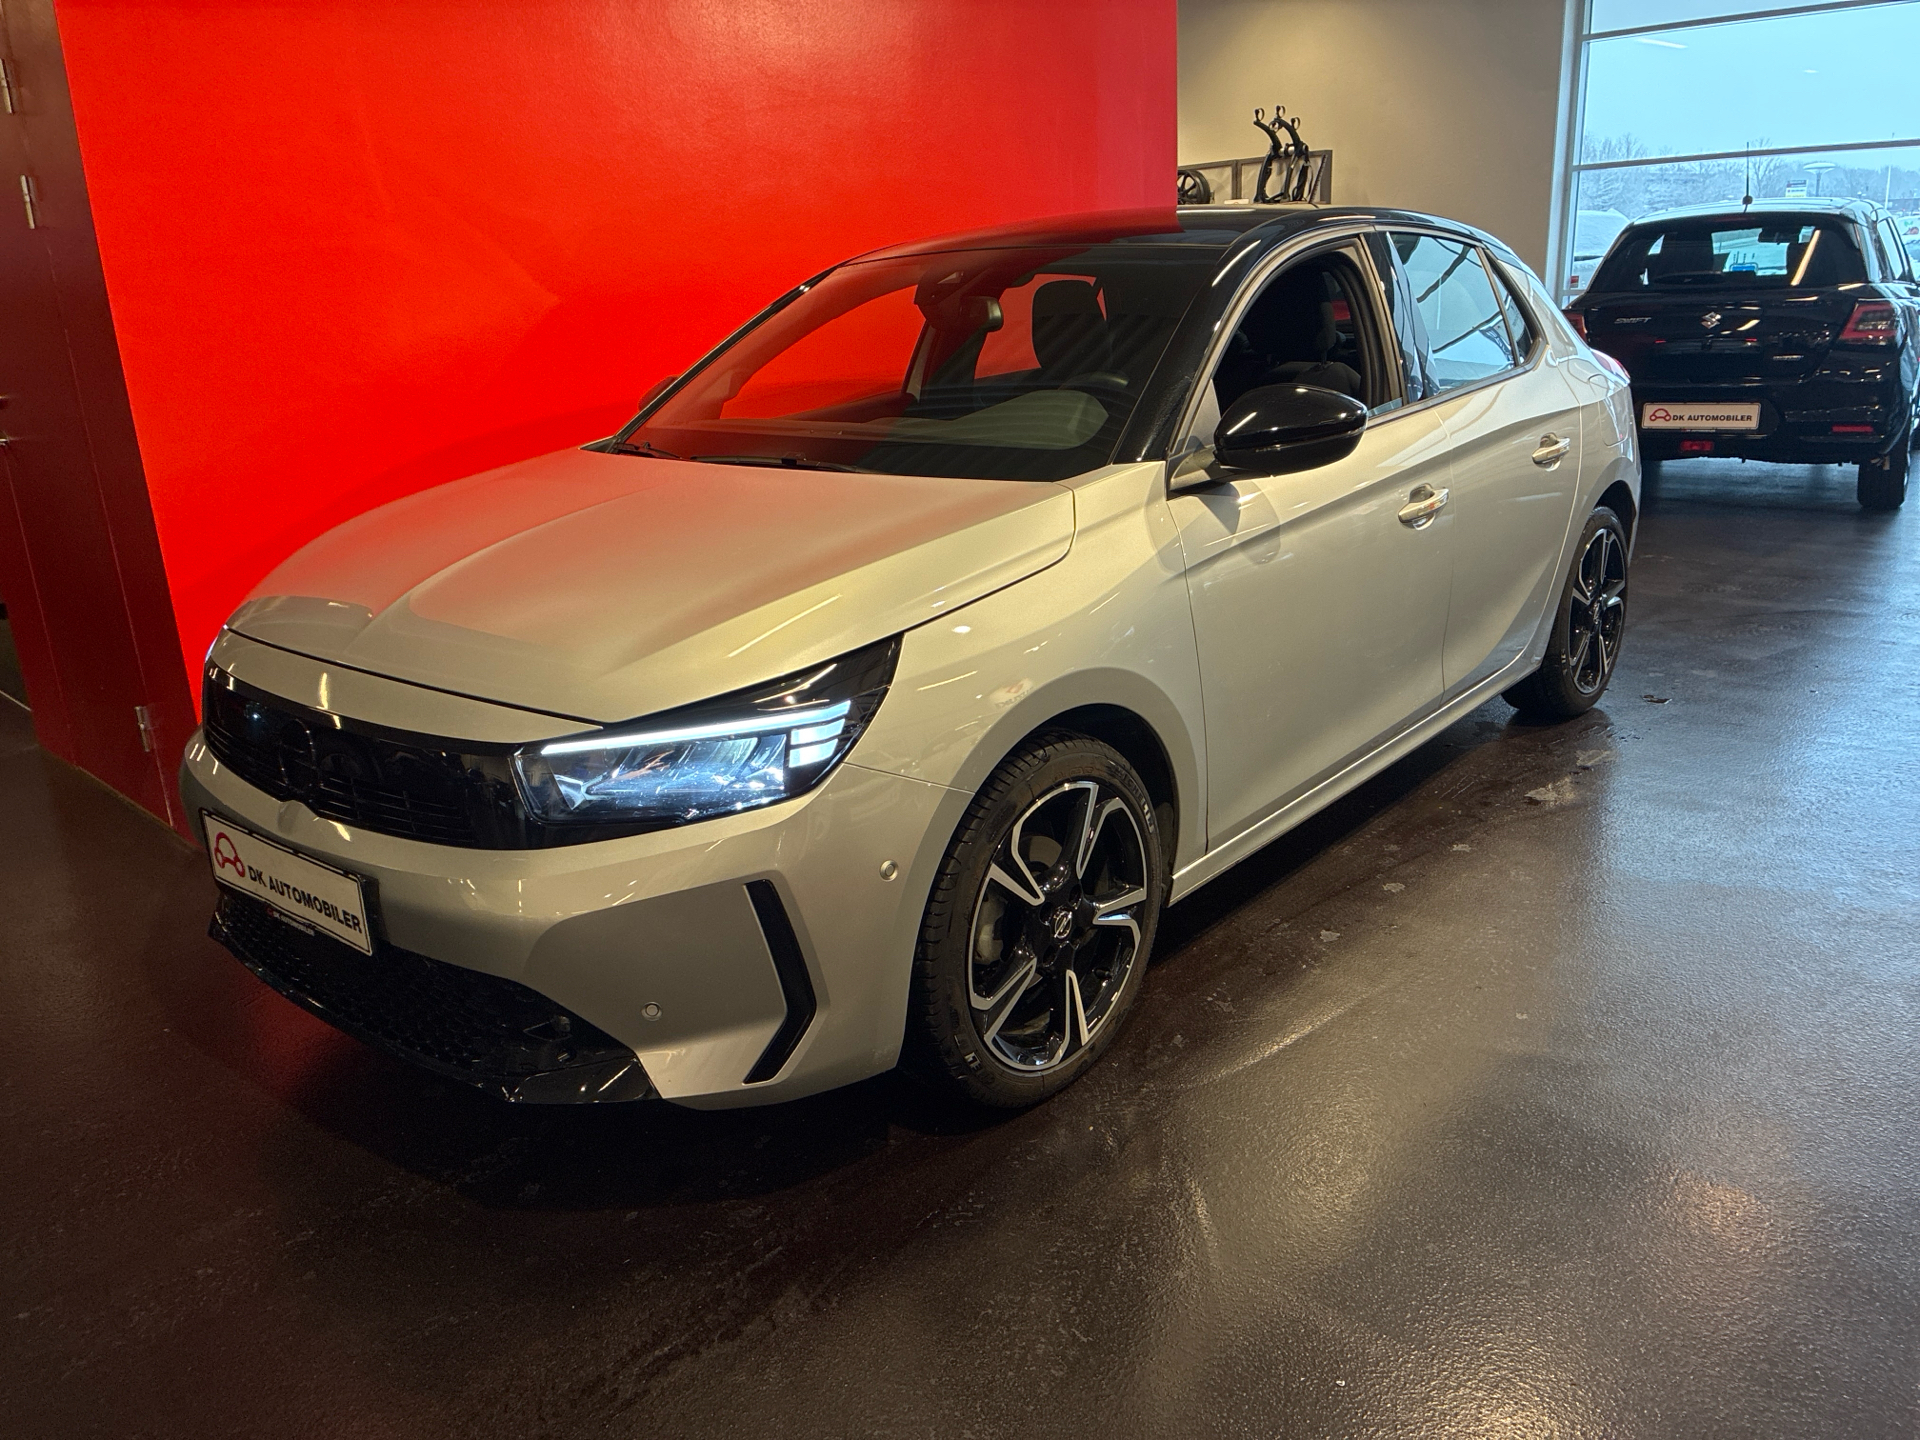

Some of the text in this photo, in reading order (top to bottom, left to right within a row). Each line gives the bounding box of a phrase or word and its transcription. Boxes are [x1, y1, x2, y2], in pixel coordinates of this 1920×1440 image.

[1672, 414, 1753, 422] DK AUTOMOBILER
[247, 865, 267, 888] DK
[268, 875, 363, 934] AUTOMOBILER
